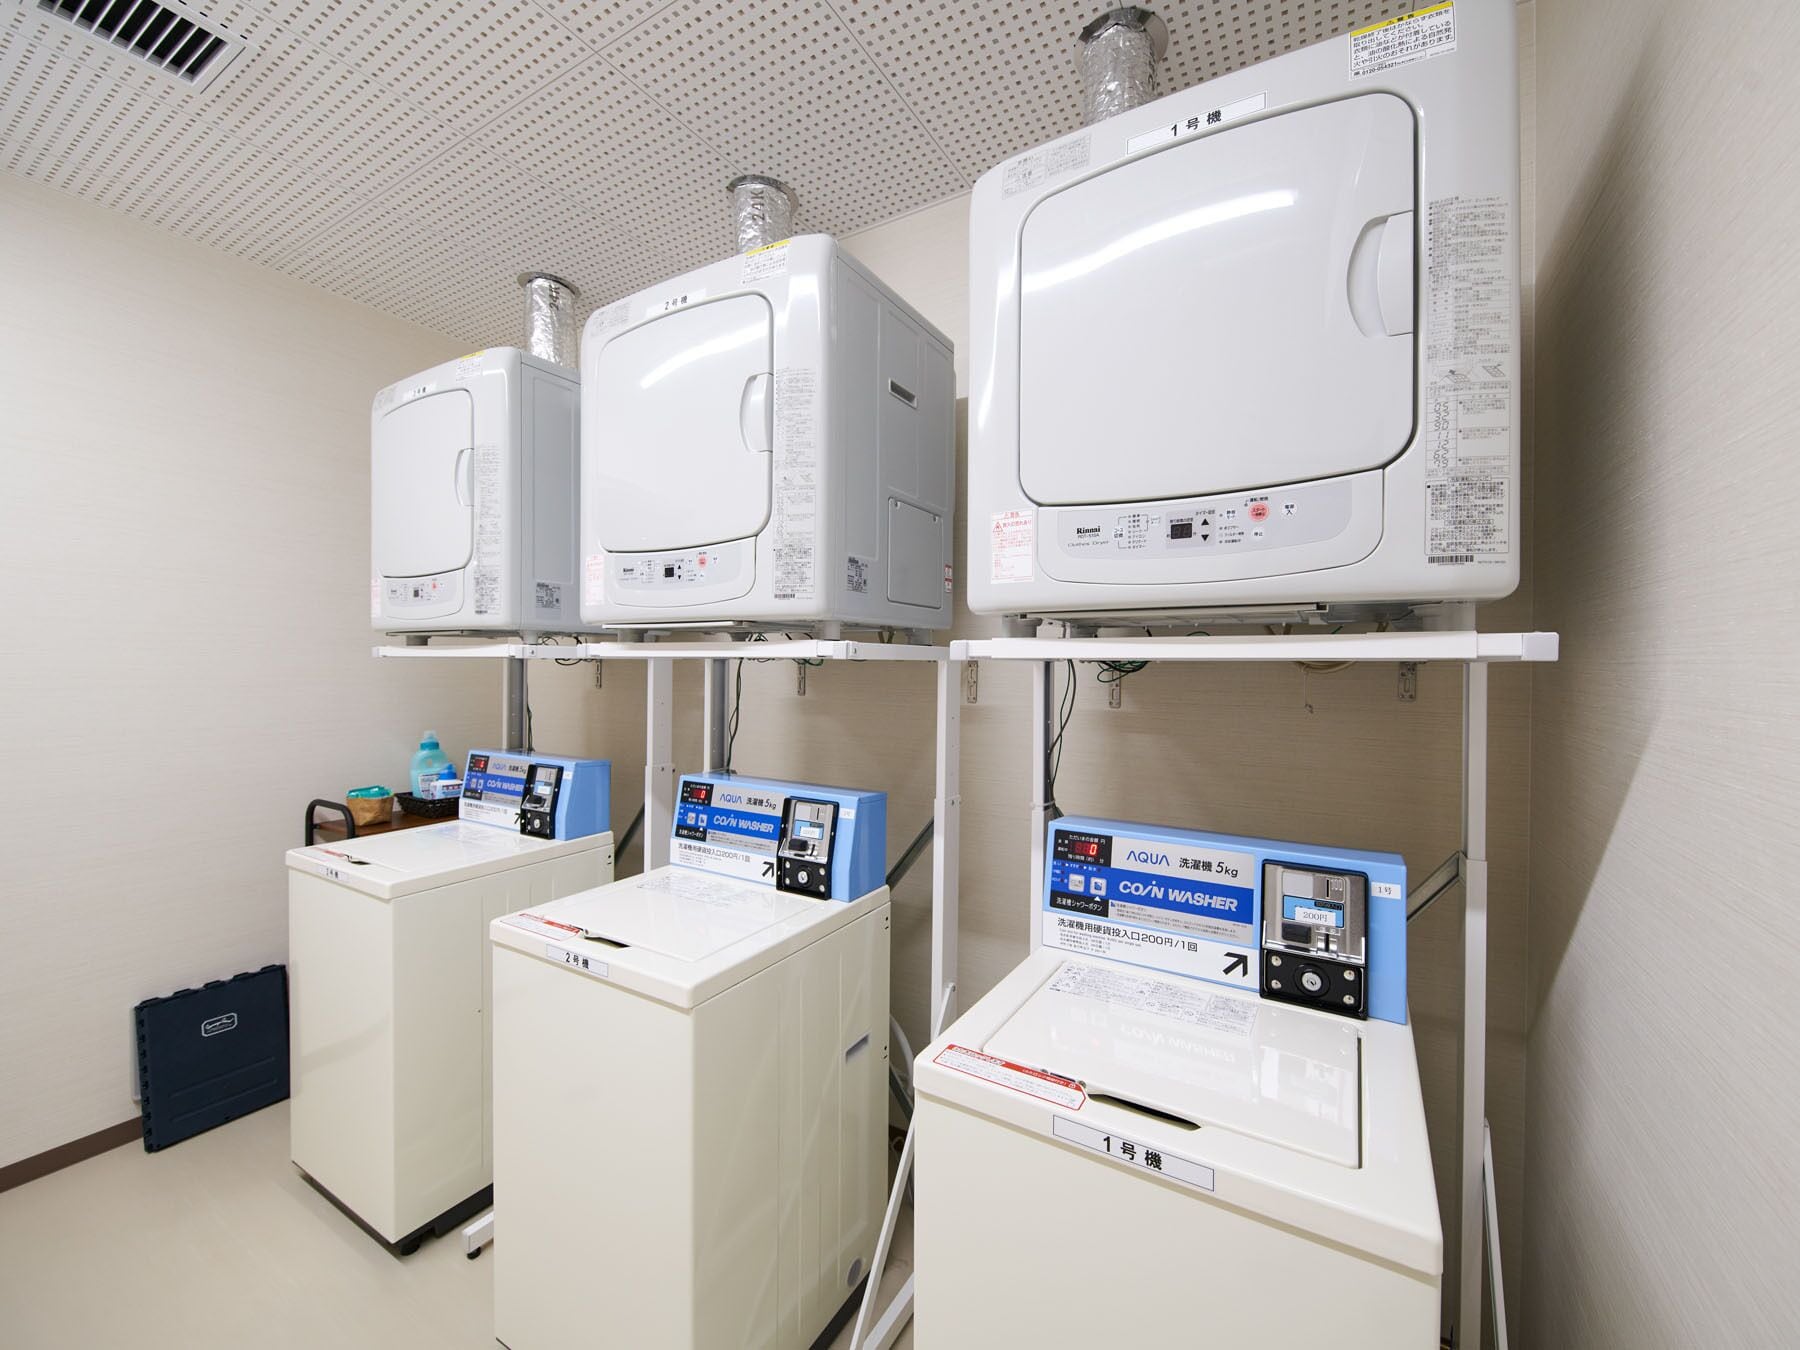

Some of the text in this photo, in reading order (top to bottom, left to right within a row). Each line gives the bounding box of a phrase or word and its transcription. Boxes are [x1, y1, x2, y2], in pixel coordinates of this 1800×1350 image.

[1171, 110, 1222, 136] 1号機
[1076, 526, 1100, 534] Rinnai
[700, 790, 706, 798] 0
[720, 794, 742, 804] AQUA
[746, 797, 777, 810] 洗濯機 5kg
[738, 818, 774, 833] WASHER
[1089, 844, 1097, 855] 0
[1126, 850, 1170, 866] AQUA
[1179, 857, 1238, 878] 洗濯機 5kg
[1056, 897, 1102, 911] 洗濯機シャワーボタン
[1119, 880, 1238, 913] COIN WASHER
[1303, 912, 1328, 922] 200円
[1057, 917, 1198, 952] 洗濯機用硬貨投入口200円/1回
[565, 952, 589, 970] 2号機
[1103, 1136, 1162, 1170] 1号機
